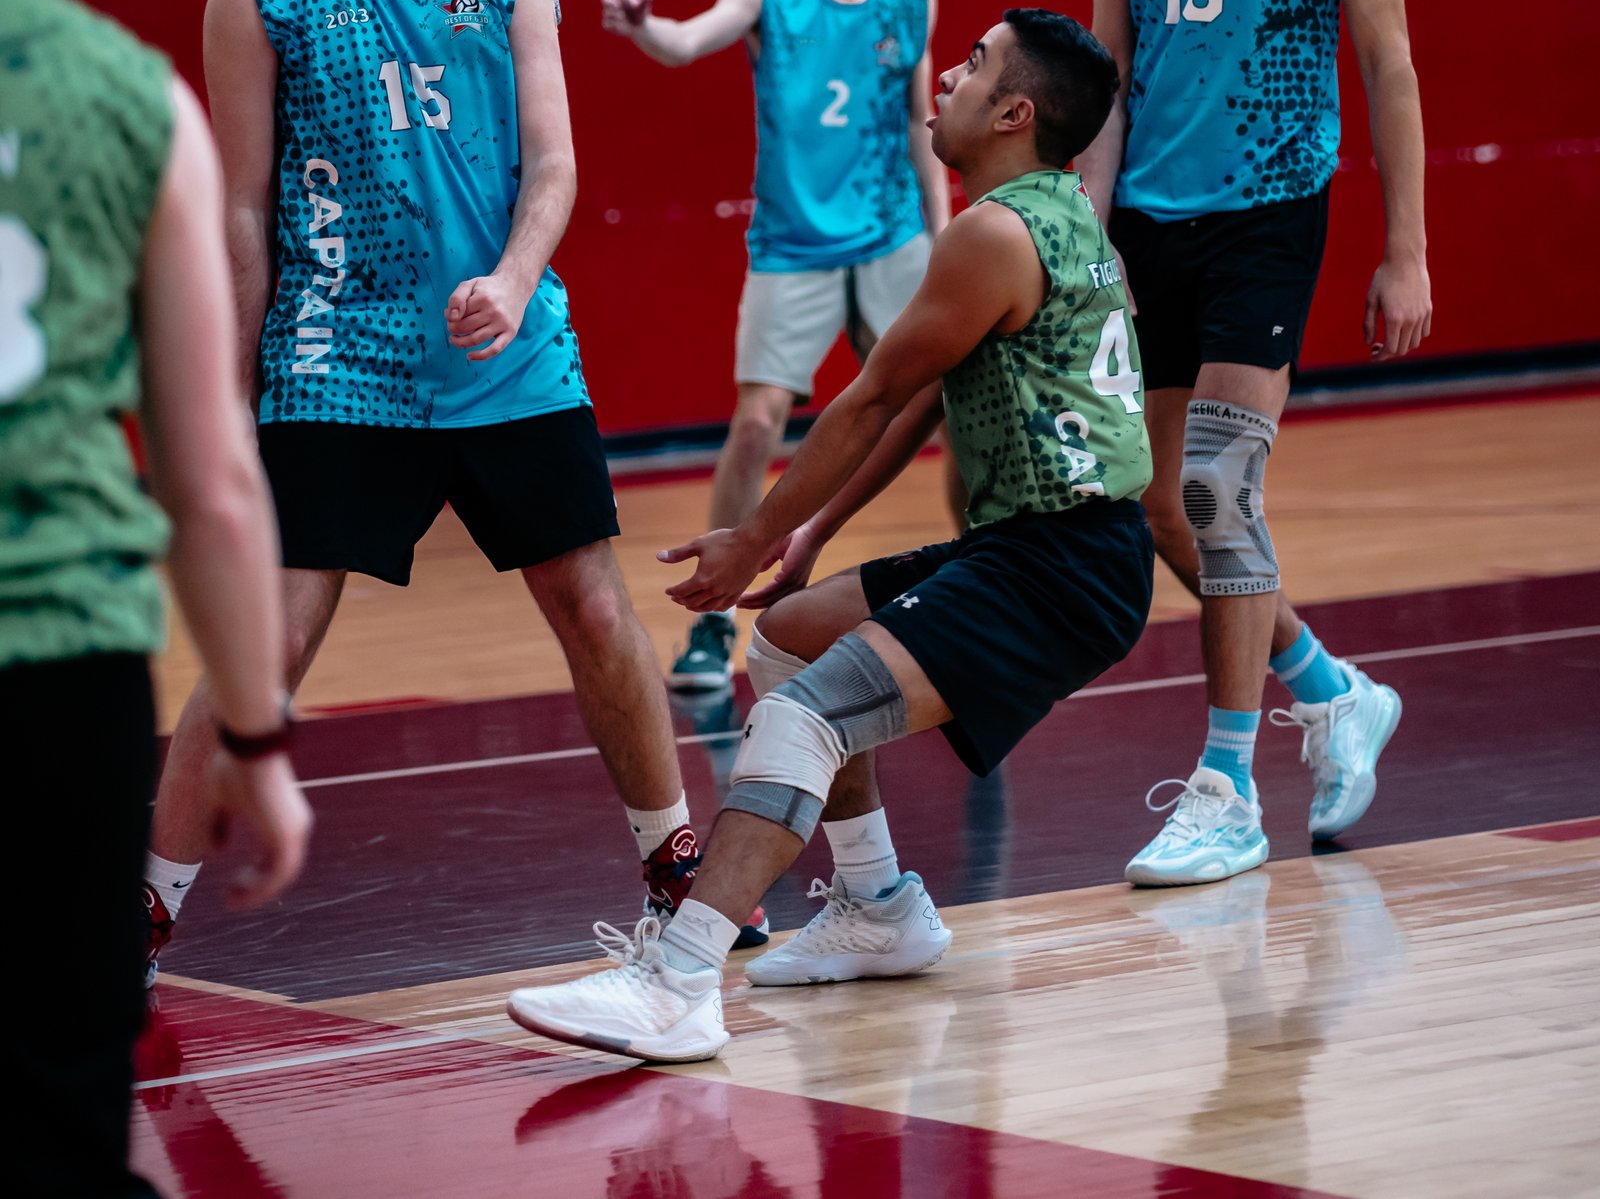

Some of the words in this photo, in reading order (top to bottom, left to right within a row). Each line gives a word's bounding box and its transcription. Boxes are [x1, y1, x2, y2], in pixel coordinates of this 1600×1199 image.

[325, 7, 371, 30] 2023
[444, 15, 462, 25] BEST
[377, 59, 453, 132] 15
[819, 79, 850, 128] 2
[291, 157, 346, 375] CAPTAIN
[1087, 307, 1143, 415] 4
